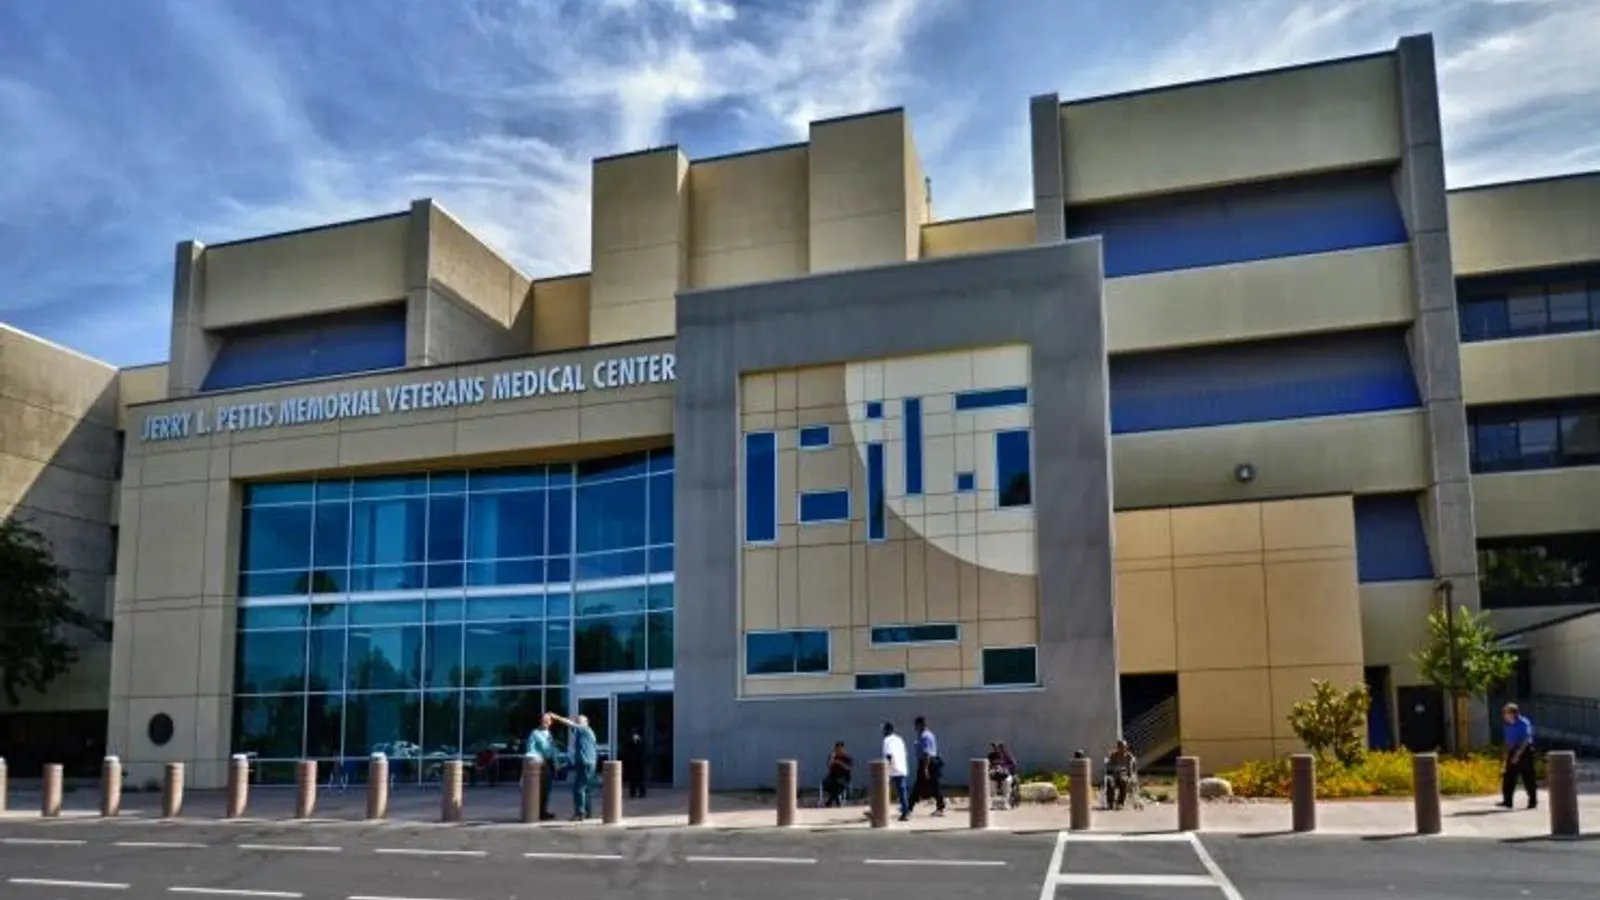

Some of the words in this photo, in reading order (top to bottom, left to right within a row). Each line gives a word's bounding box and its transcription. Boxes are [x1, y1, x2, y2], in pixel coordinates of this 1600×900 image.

[141, 414, 191, 441] JERRY
[197, 415, 210, 434] L.
[217, 403, 273, 431] PETTIS
[280, 390, 380, 424] MEMORIAL
[386, 377, 485, 411] VETERANS
[492, 365, 585, 399] MEDICAL
[593, 353, 676, 388] CENTER
